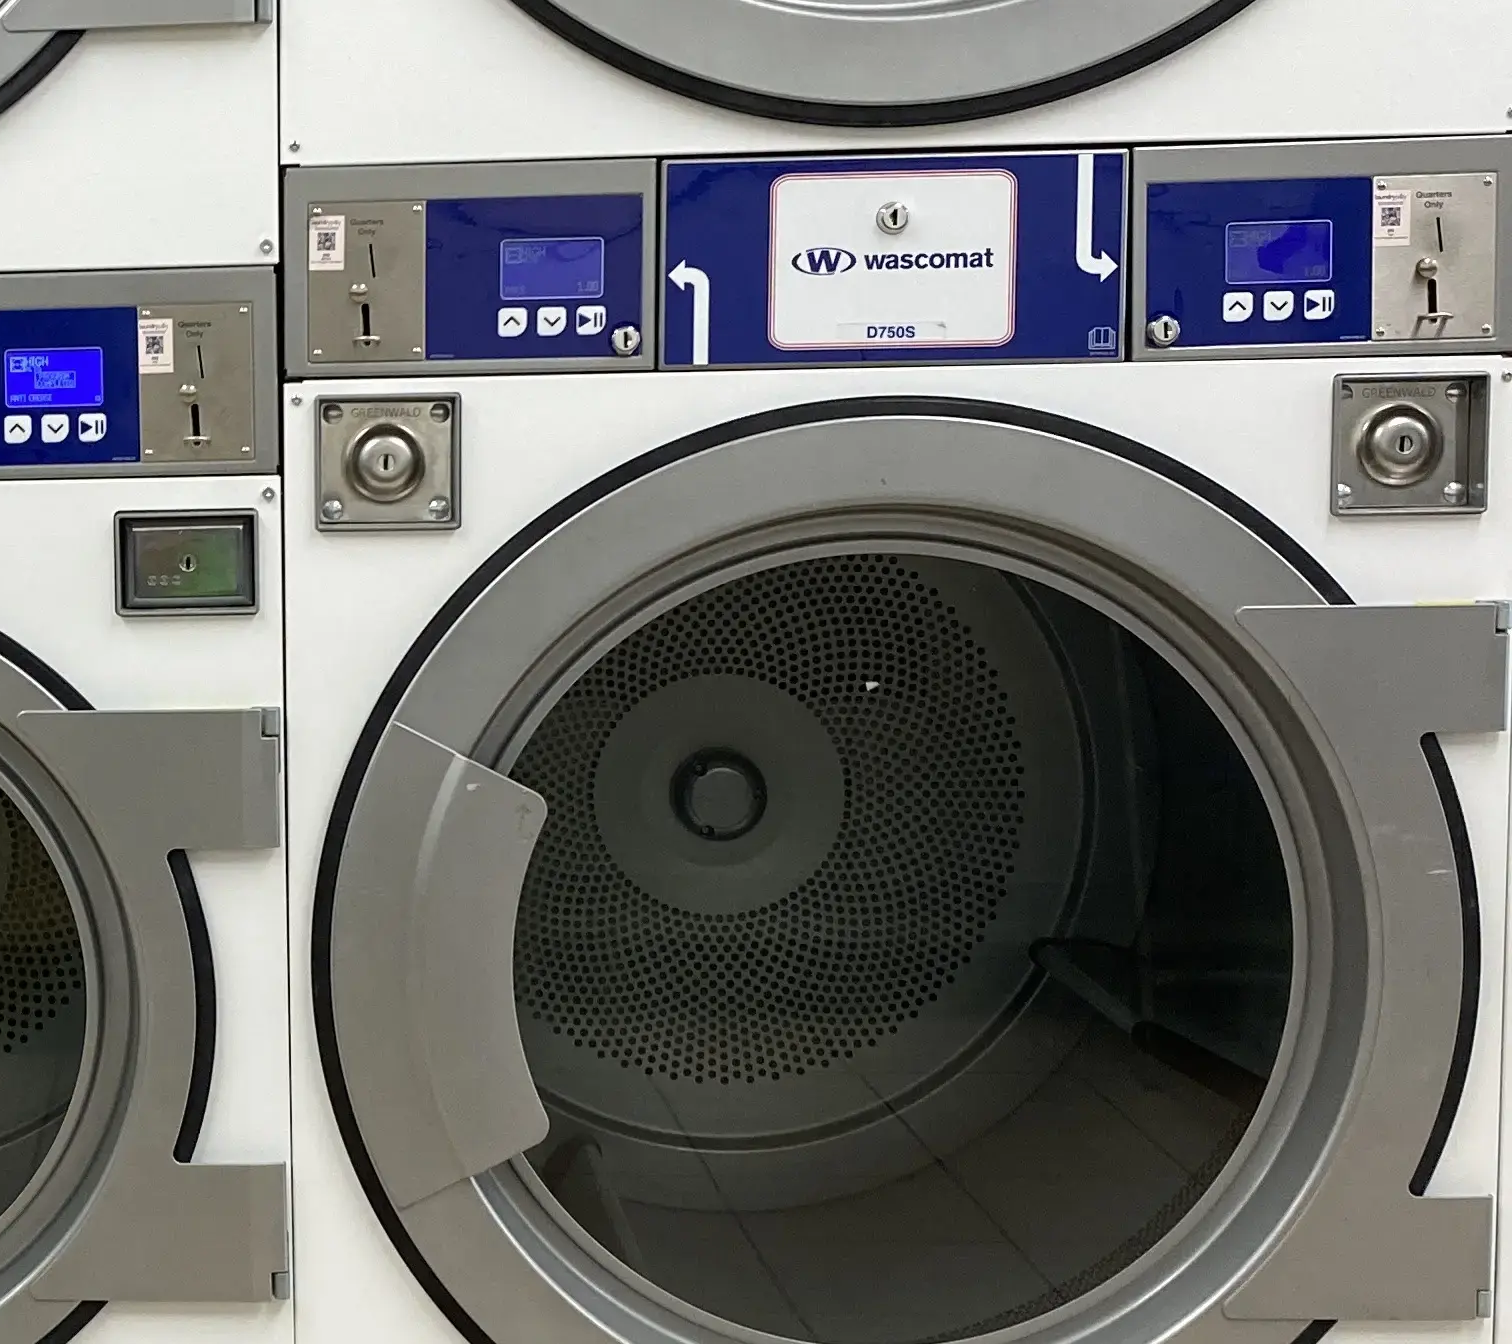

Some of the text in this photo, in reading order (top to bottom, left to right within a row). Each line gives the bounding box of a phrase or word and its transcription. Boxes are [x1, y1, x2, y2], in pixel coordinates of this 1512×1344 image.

[1424, 201, 1444, 209] Only
[864, 248, 994, 270] wascomat
[866, 326, 916, 338] D750S
[1361, 387, 1437, 398] GREENWALD
[350, 407, 422, 418] GREENWALD
